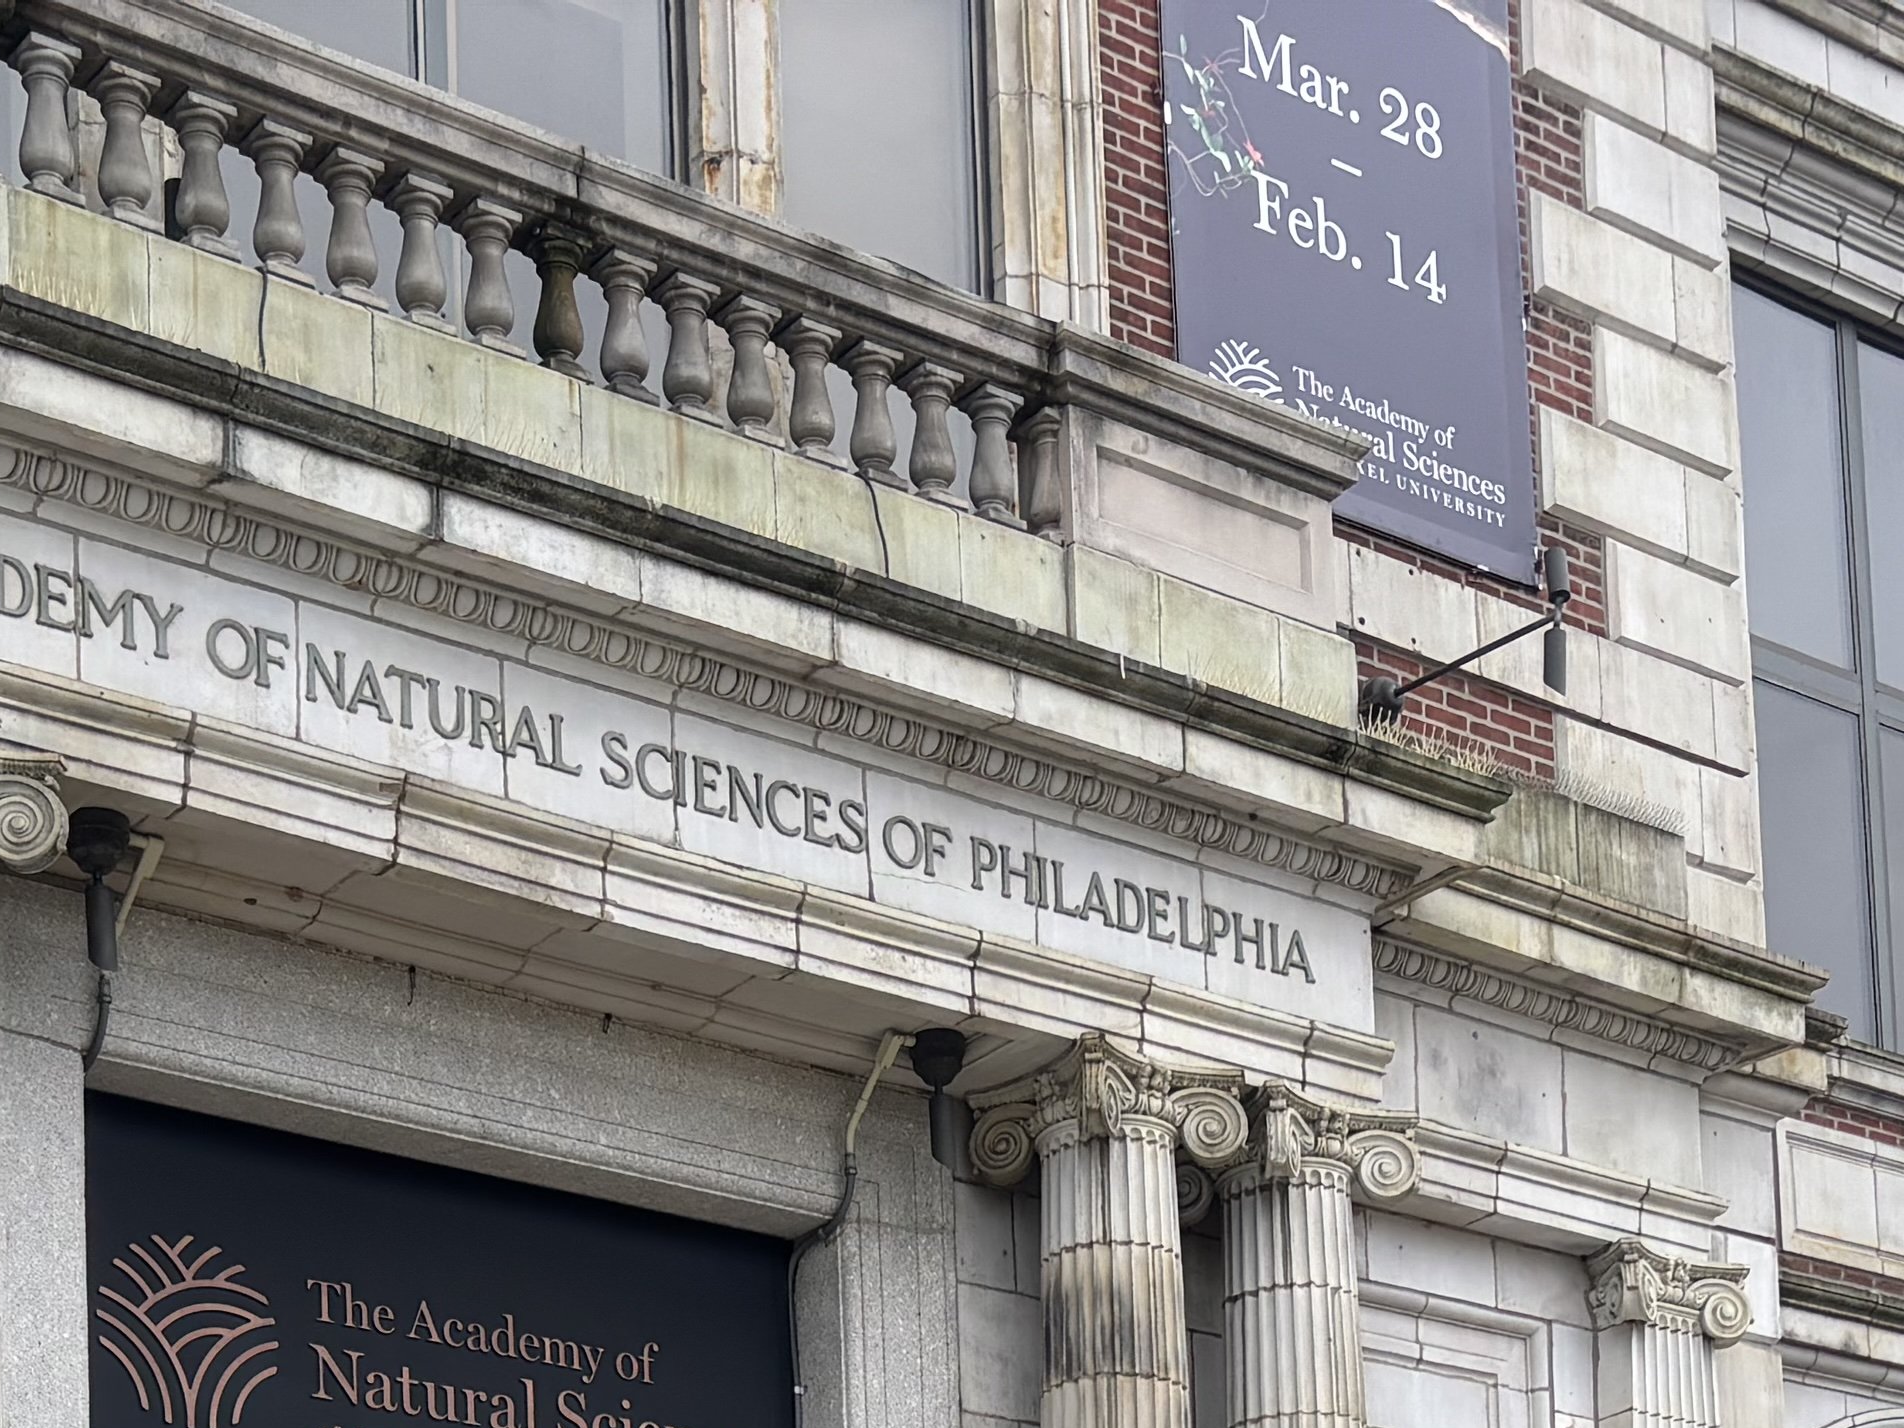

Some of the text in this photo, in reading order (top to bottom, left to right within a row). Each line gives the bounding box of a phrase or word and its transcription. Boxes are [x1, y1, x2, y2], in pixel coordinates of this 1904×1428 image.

[1237, 14, 1444, 160] Mar. 28
[1250, 169, 1447, 305] Feb. 14
[1292, 365, 1334, 402] The
[1339, 386, 1429, 443] Academy
[1434, 426, 1455, 449] of
[1396, 474, 1505, 528] UNIVERSITY
[1402, 441, 1506, 504] Sciences
[206, 616, 290, 688] OF
[305, 641, 582, 777] NATURAL
[600, 731, 866, 854] SCIENCES
[882, 815, 952, 871] OF
[971, 836, 1316, 983] PHILADELPHIA
[306, 1278, 660, 1385] The Academy of
